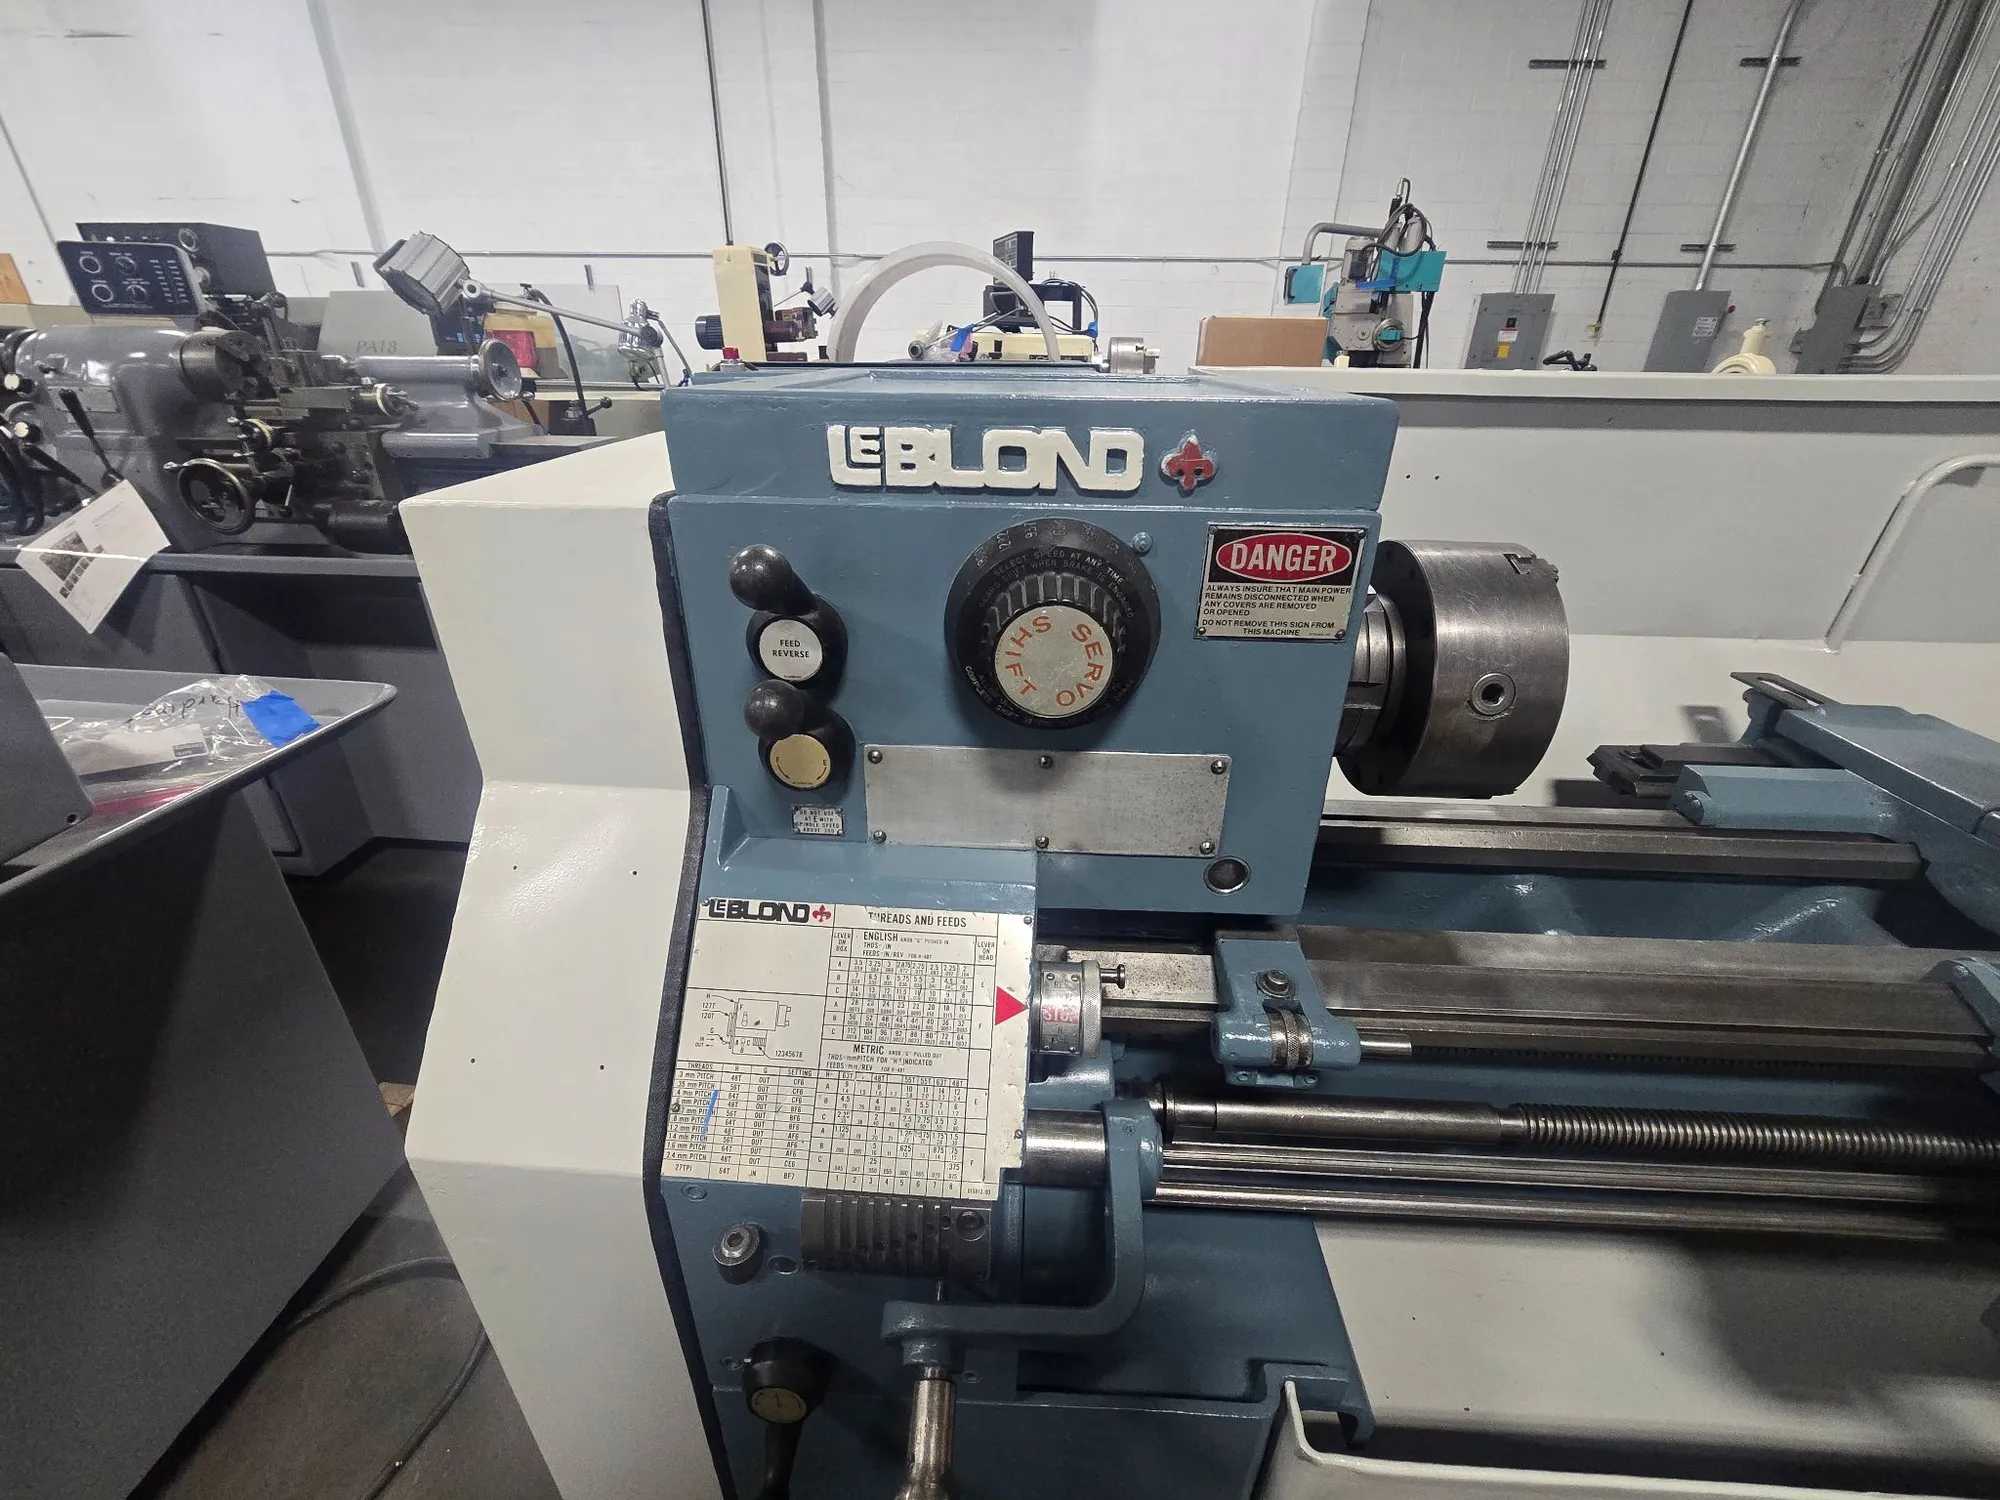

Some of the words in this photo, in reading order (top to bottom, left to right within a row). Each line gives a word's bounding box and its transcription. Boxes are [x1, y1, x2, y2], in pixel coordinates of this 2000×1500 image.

[827, 425, 1144, 490] LEBLOND
[1230, 544, 1336, 572] DANGER
[1005, 616, 1052, 696] SHIFT
[1056, 623, 1104, 706] SERVO
[709, 899, 810, 923] LEBLOND
[915, 915, 934, 925] AND
[937, 916, 967, 928] FEEDS
[864, 932, 898, 942] ENGLISH
[853, 1044, 884, 1055] METRIC
